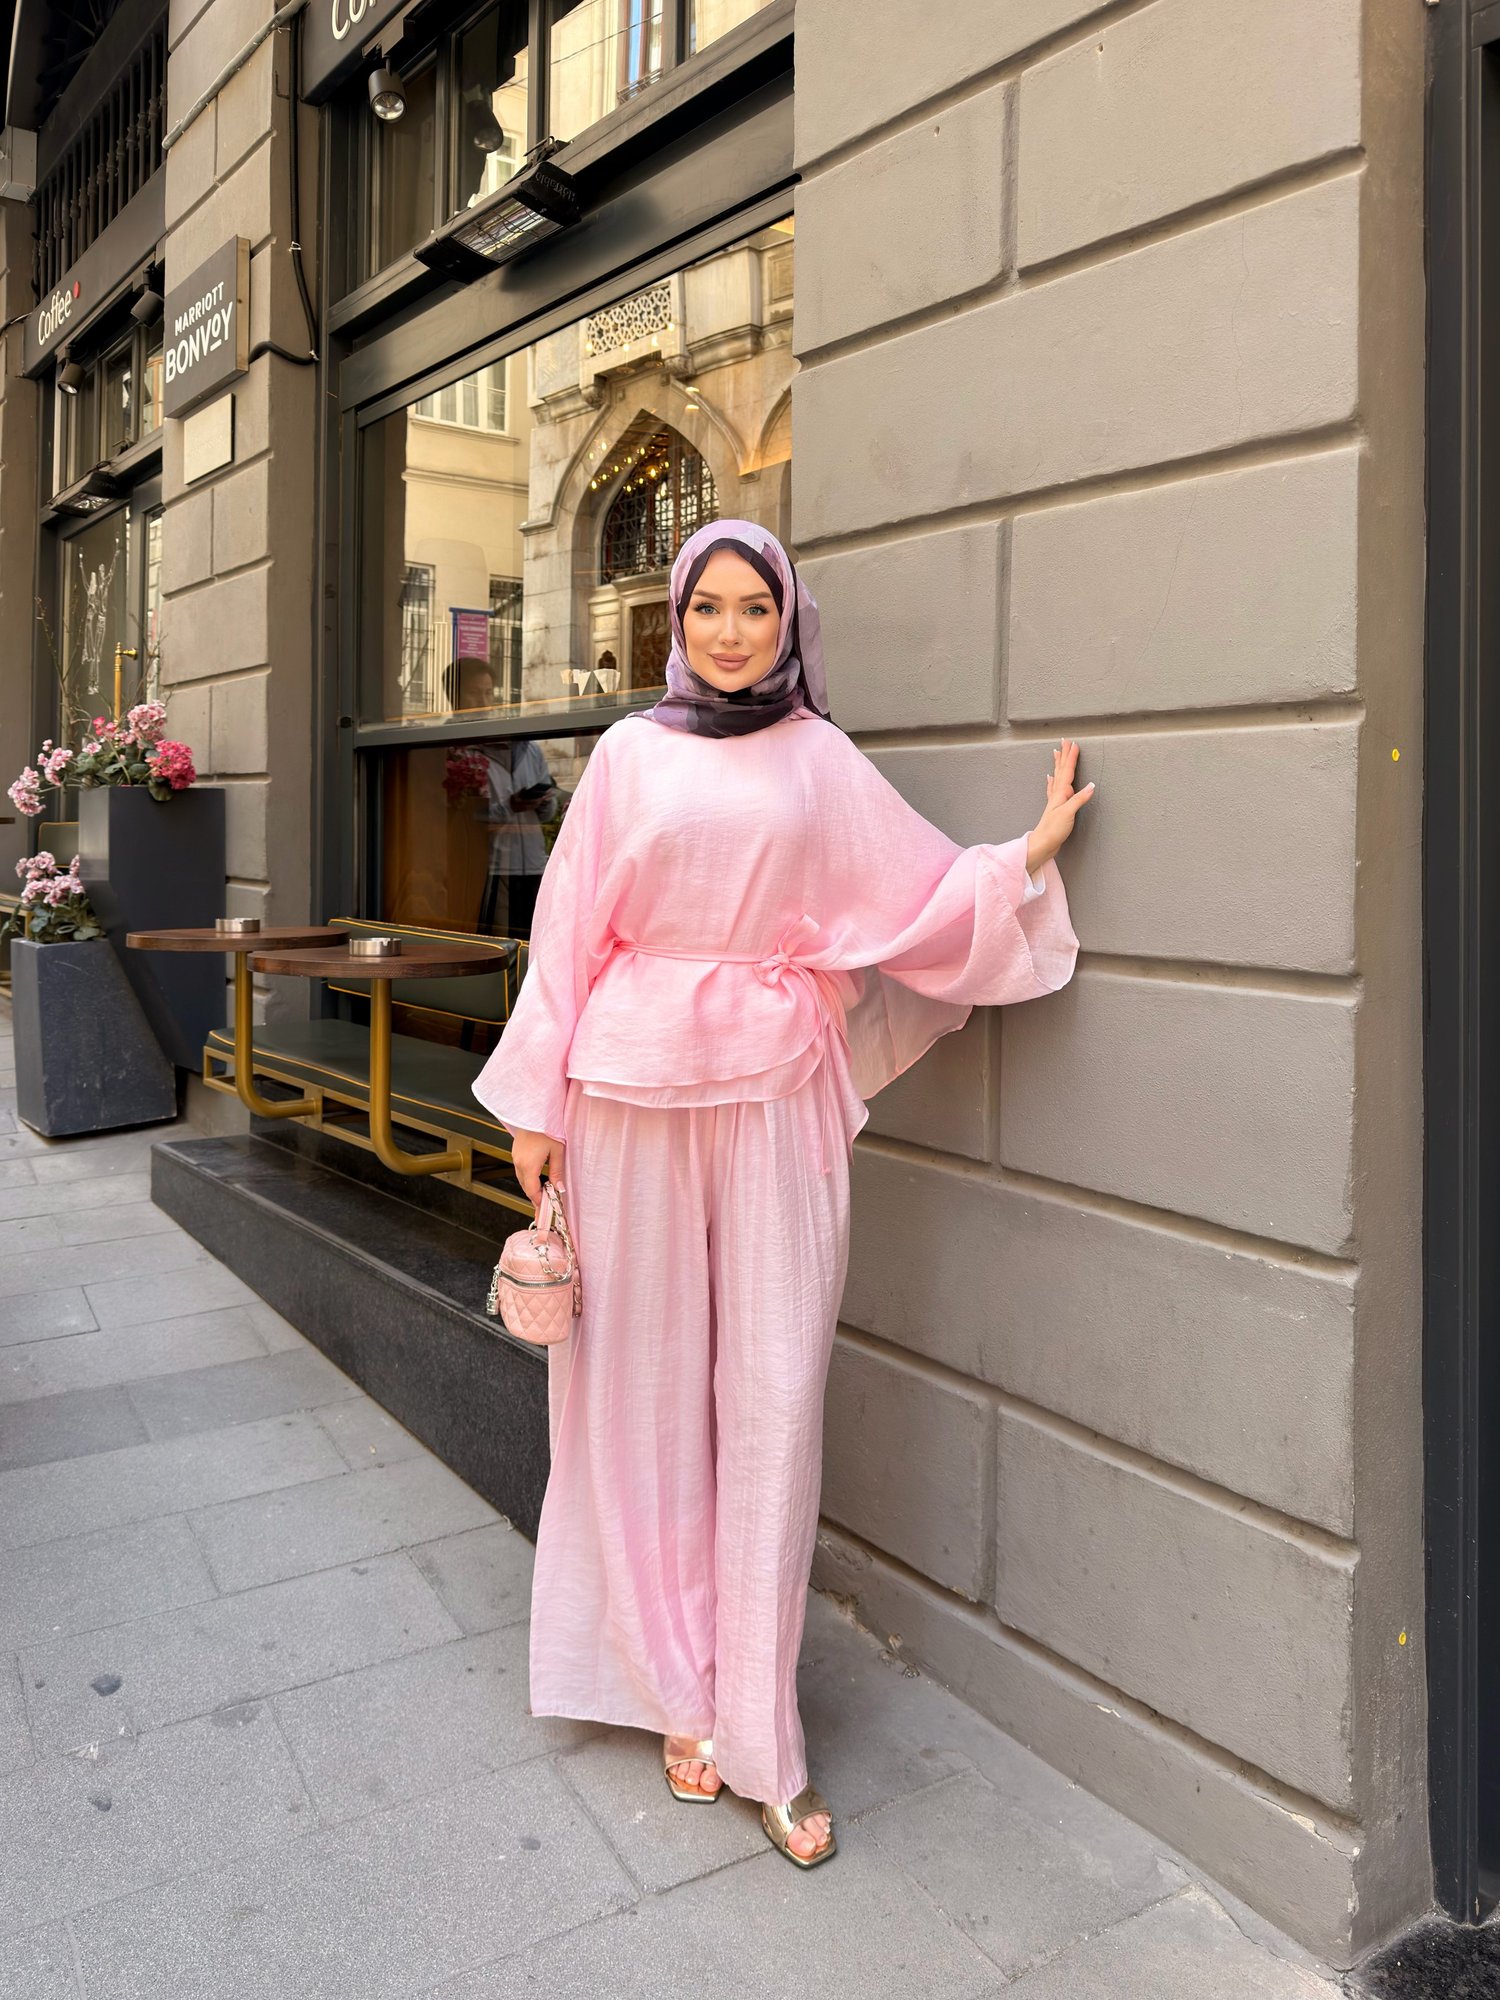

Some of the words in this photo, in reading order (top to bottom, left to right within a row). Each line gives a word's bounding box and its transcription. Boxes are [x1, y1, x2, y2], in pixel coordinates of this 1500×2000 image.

[38, 289, 73, 346] Coffee
[174, 281, 225, 337] MARRIOTT
[165, 301, 233, 384] BONVOY
